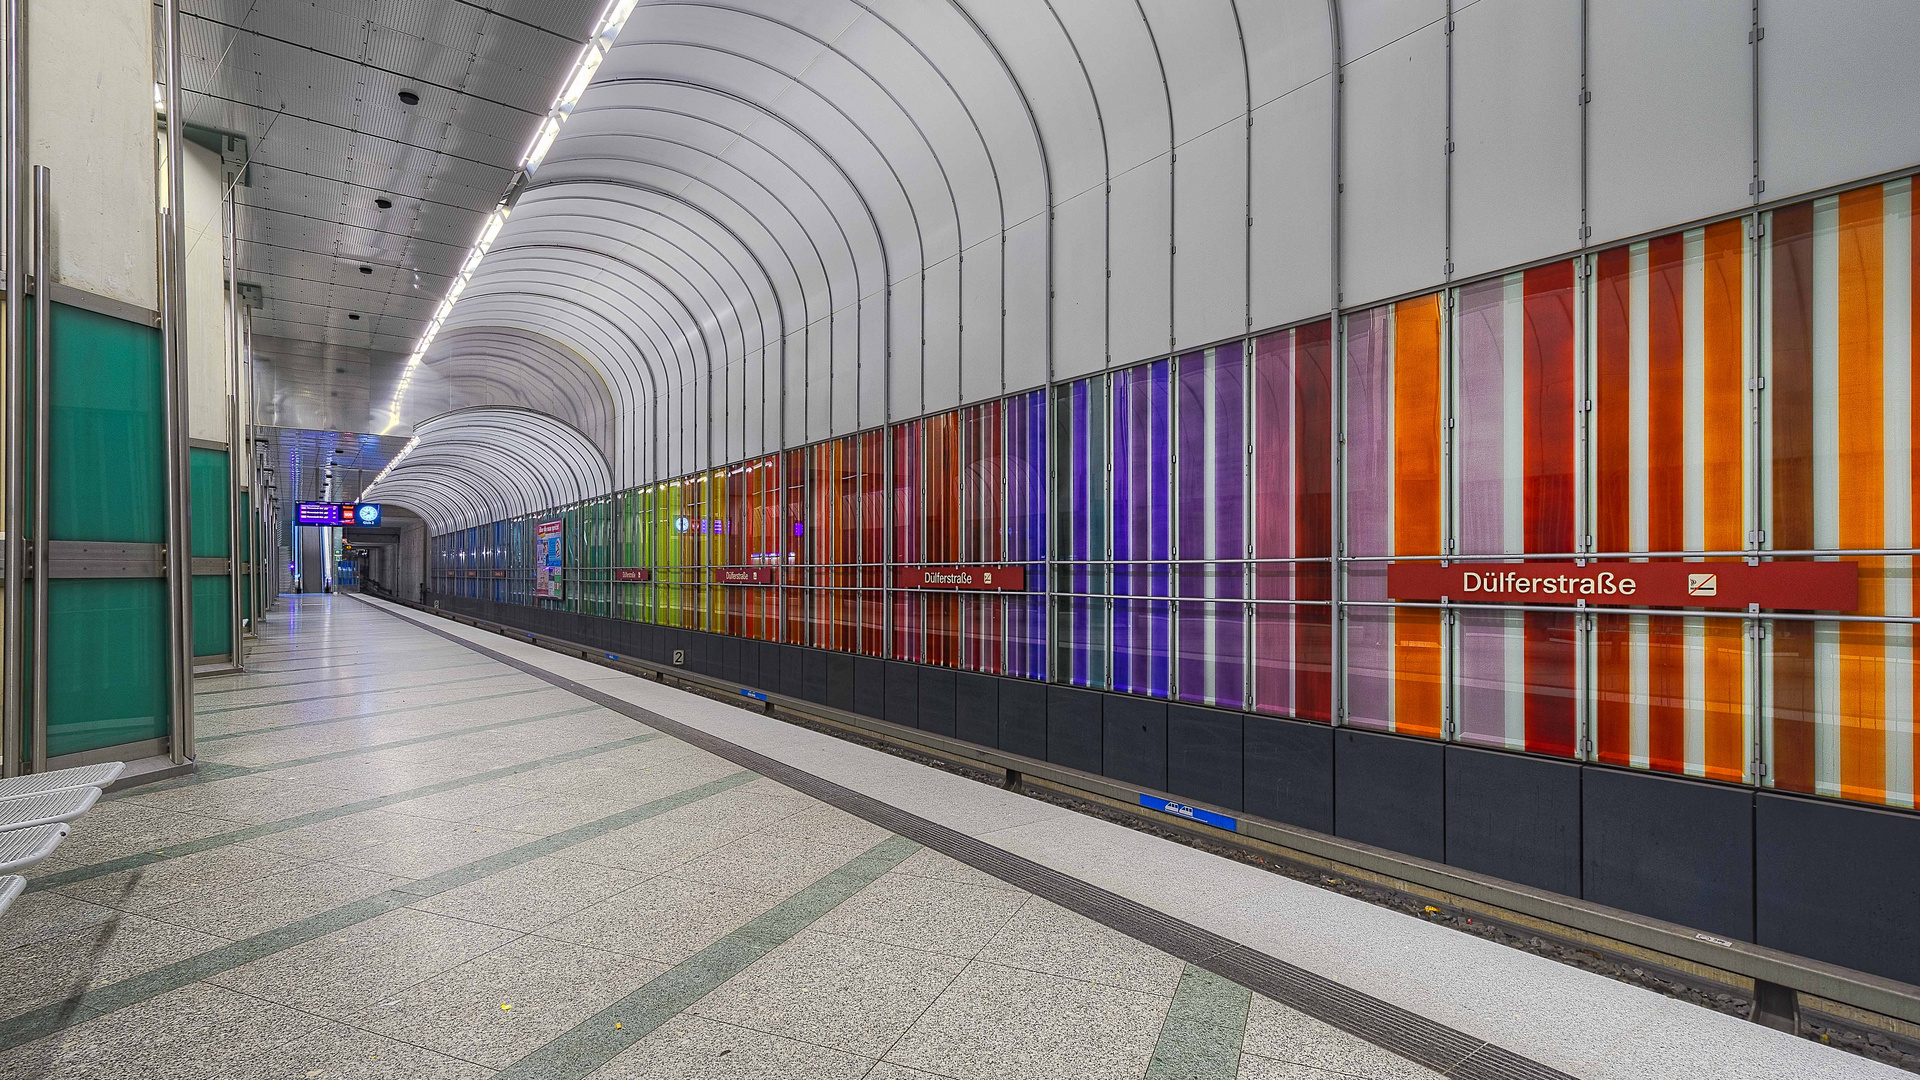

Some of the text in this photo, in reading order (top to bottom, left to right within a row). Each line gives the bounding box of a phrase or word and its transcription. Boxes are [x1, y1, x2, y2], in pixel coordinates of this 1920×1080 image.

[924, 571, 972, 584] Dülferstraße
[1463, 571, 1637, 595] Dülferstraße
[675, 651, 682, 662] 2
